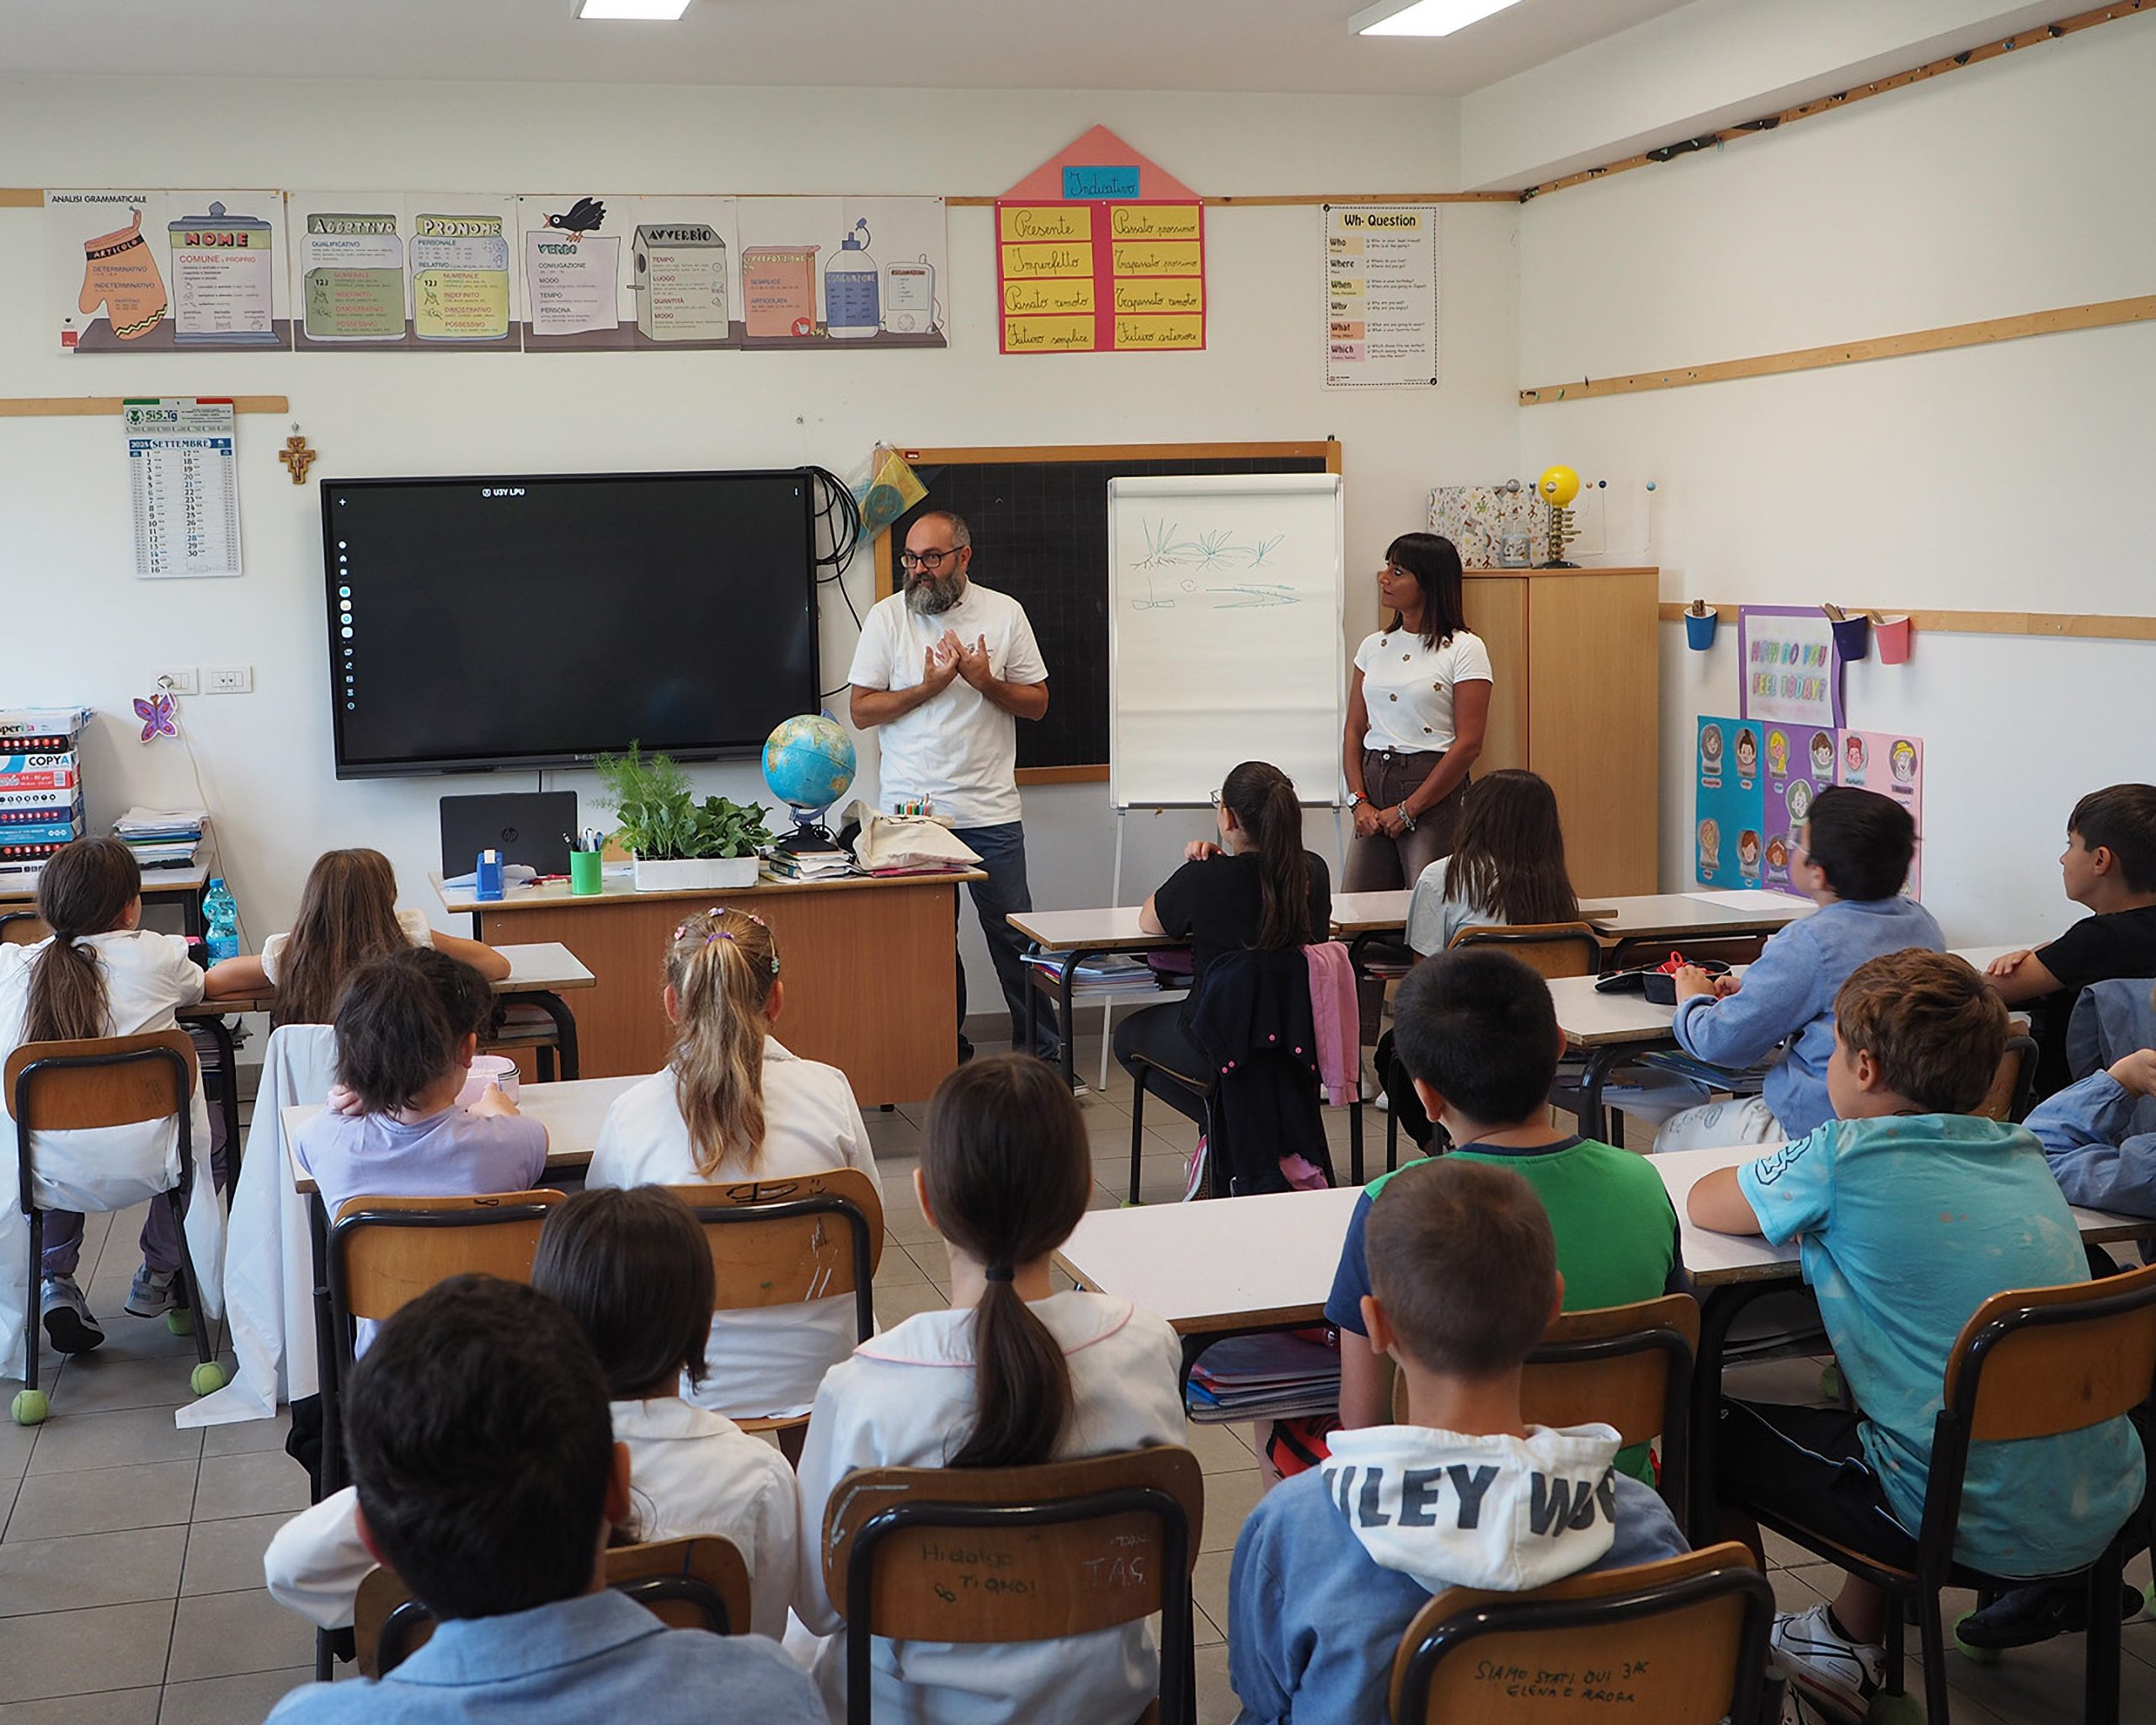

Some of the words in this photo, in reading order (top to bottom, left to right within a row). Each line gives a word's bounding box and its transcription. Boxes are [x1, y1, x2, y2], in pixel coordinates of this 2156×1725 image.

[1070, 171, 1135, 195] Indicativo
[85, 195, 147, 204] GRAMMATICALE
[1015, 211, 1074, 237] Presente
[1113, 209, 1153, 235] Passato
[1368, 214, 1416, 227] Question
[185, 232, 249, 247] NOME
[649, 228, 711, 241] AVVERBIO
[94, 240, 137, 258] ARTICOLO
[538, 244, 578, 254] VERBO
[1012, 248, 1079, 275] Imperfetto
[1330, 259, 1354, 268] Where
[1005, 286, 1049, 310] Passato
[1056, 291, 1089, 309] remoto
[1168, 291, 1198, 307] remoto
[1331, 302, 1348, 310] Why
[1007, 323, 1043, 346] Futuro
[1051, 334, 1089, 349] semplice
[1118, 322, 1155, 343] Futuro
[1331, 323, 1350, 332] What
[1752, 641, 1780, 663] HOW
[1781, 642, 1799, 665] DO
[1803, 644, 1827, 667] YOU
[1753, 673, 1777, 696] FEEL
[1780, 676, 1827, 702] TODAY?
[960, 1574, 979, 1590] Ti
[1475, 1660, 1529, 1682] SIAMO
[1534, 1670, 1574, 1685] STATI
[1506, 1685, 1557, 1697] ELENA
[1563, 1686, 1573, 1697] E
